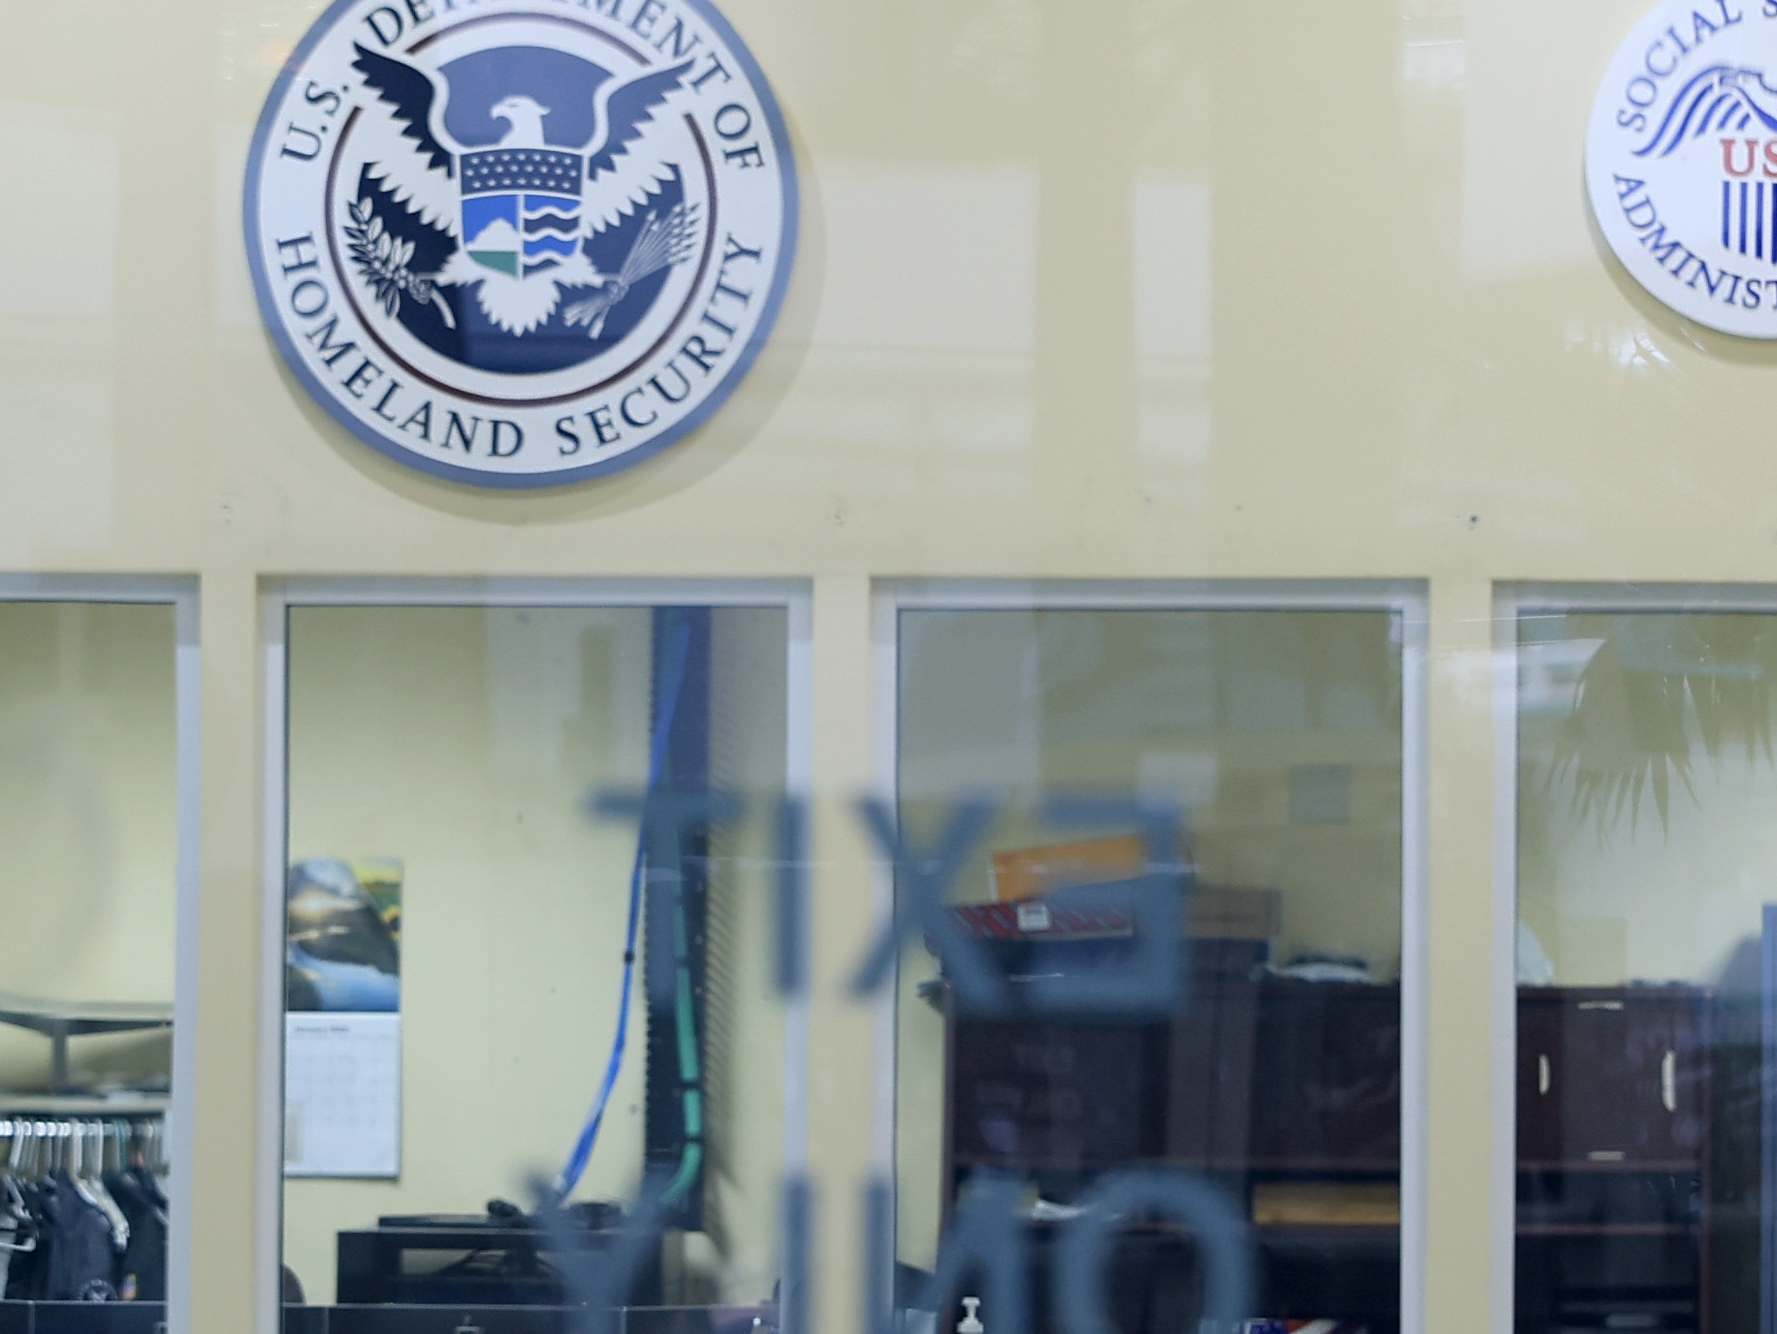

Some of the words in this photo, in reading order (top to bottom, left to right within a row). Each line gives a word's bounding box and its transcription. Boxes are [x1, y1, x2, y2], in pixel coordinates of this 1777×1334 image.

[280, 79, 350, 164] U.S.
[713, 100, 765, 170] OF
[275, 230, 524, 459] HOMELAND
[554, 233, 764, 458] SECURITY
